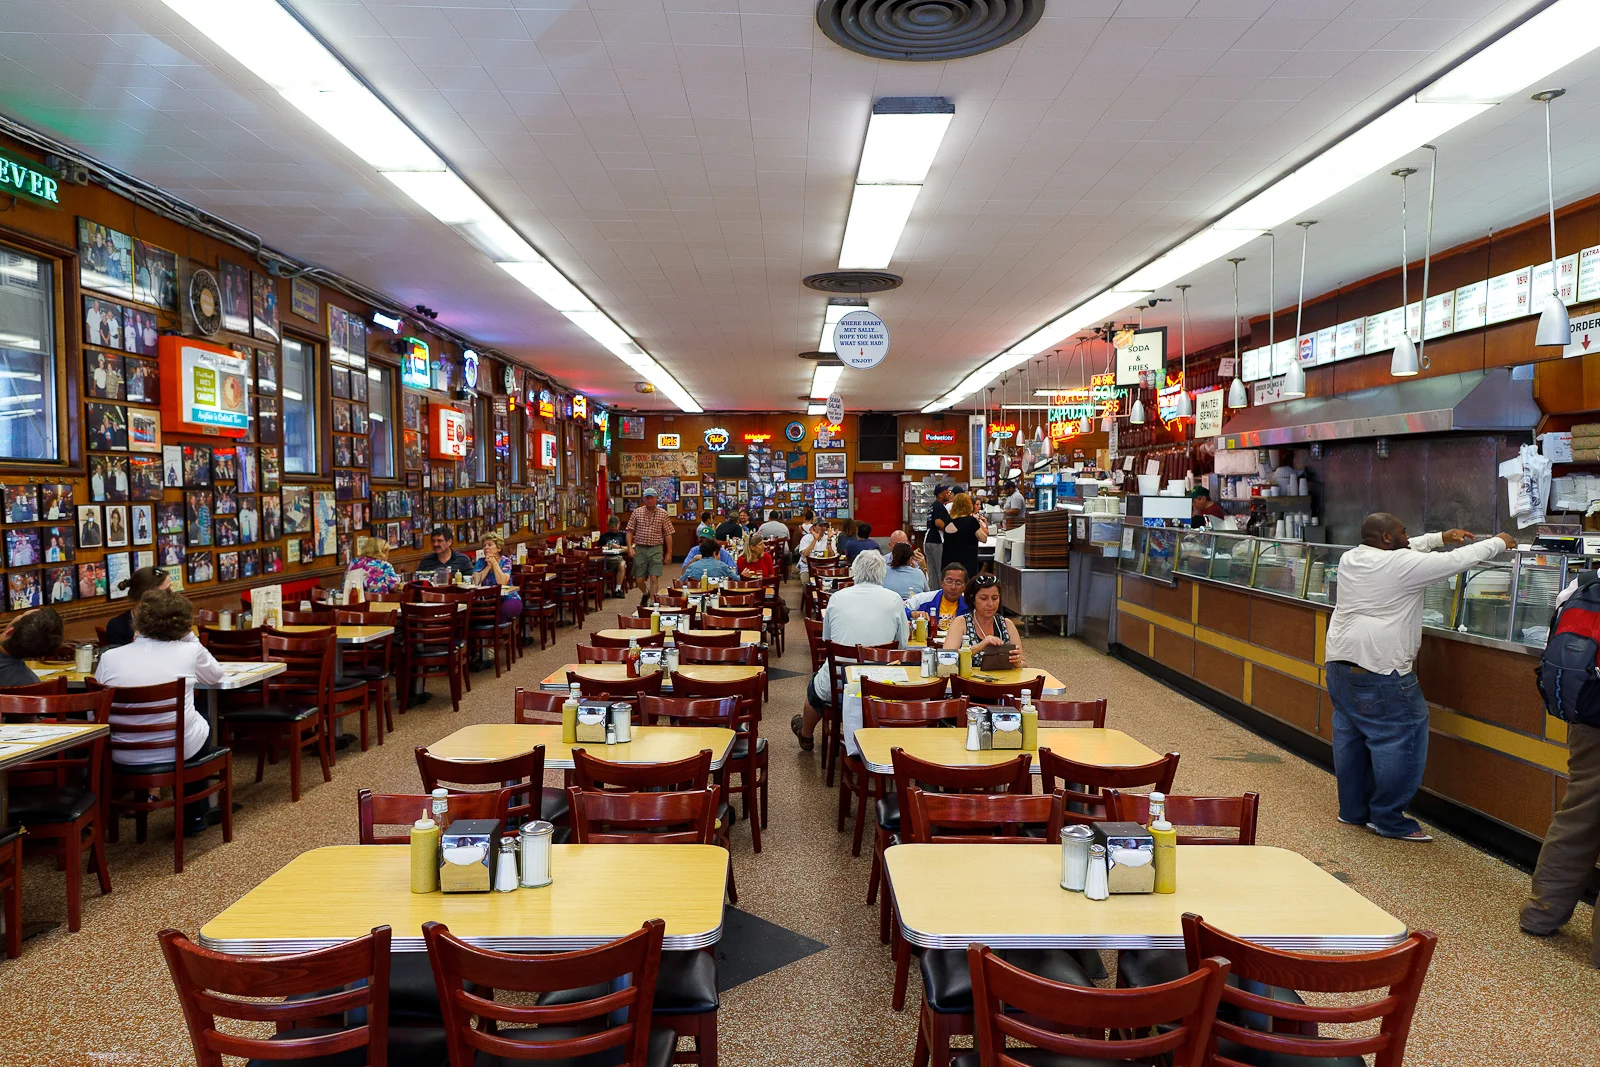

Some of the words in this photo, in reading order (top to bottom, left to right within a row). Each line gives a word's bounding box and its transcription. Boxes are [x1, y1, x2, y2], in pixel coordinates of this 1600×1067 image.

[0, 157, 60, 204] EVER
[1128, 344, 1150, 353] SODA
[1128, 363, 1149, 372] FRIES
[1200, 398, 1219, 410] WAITER
[1199, 410, 1219, 420] SERVICE
[1200, 421, 1211, 430] ONLY
[925, 433, 954, 441] Budweiser
